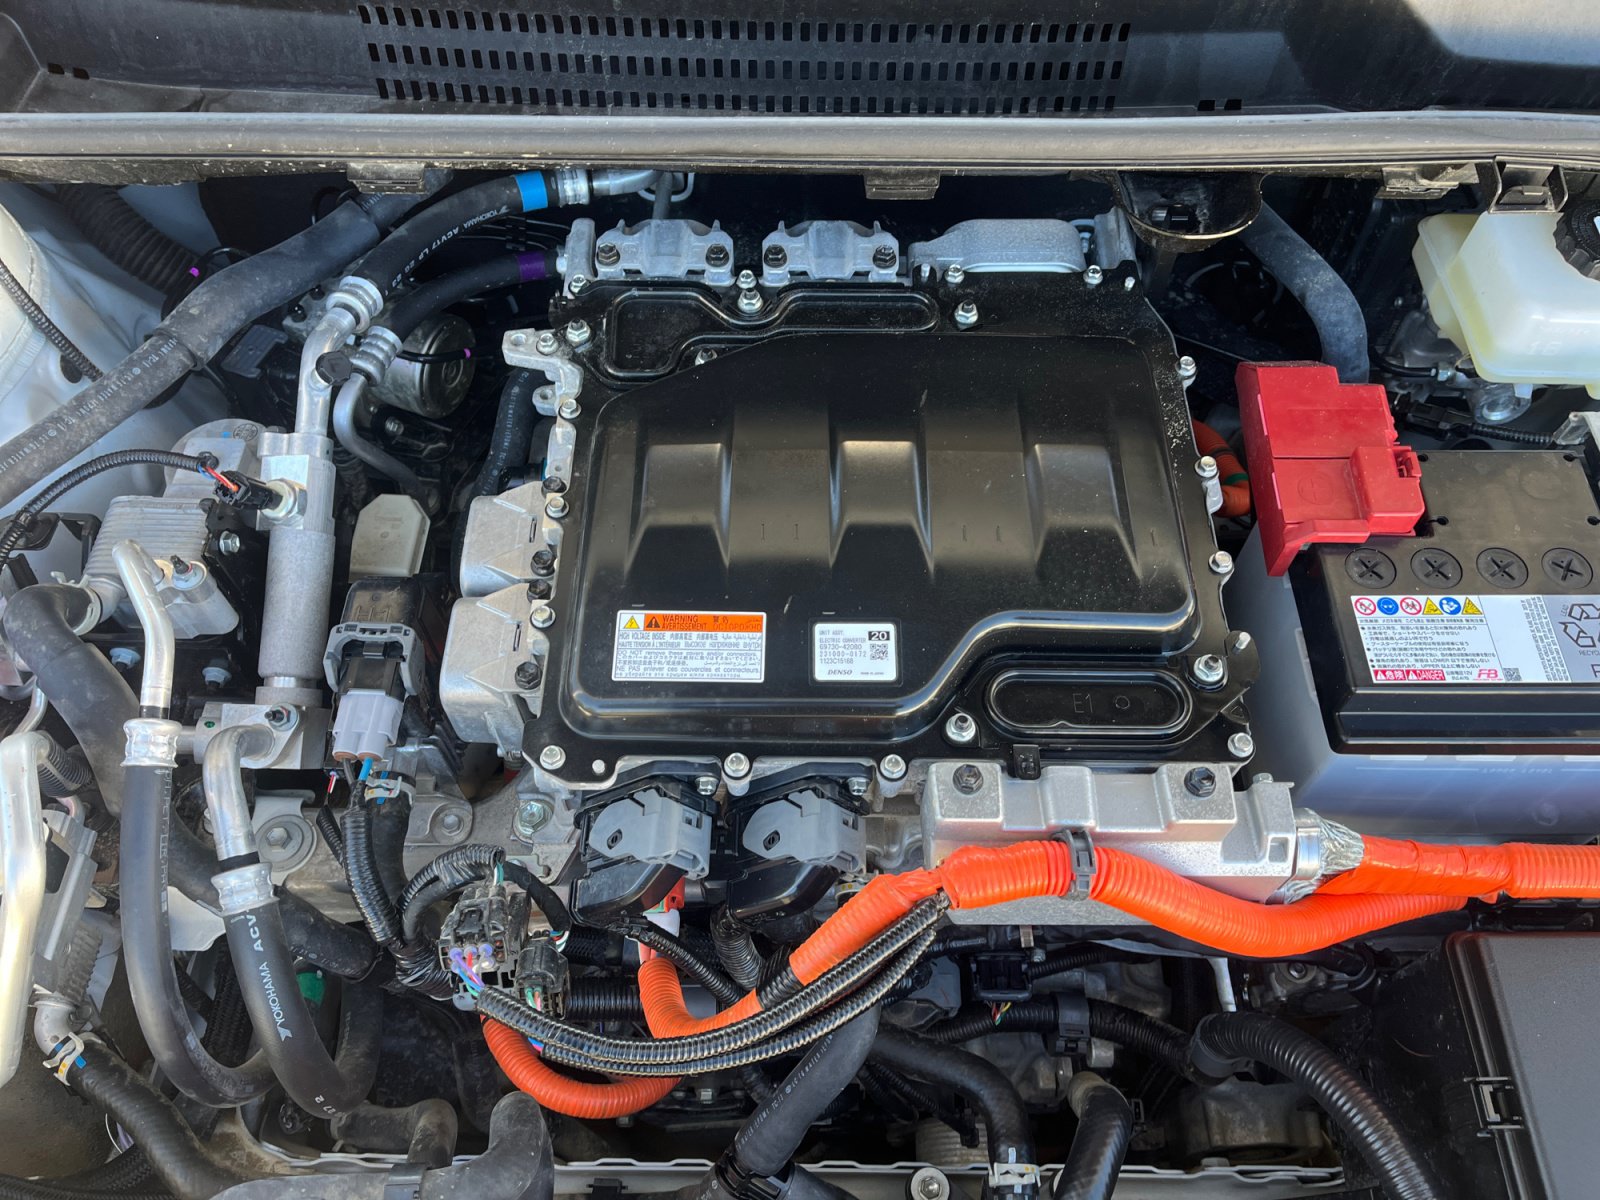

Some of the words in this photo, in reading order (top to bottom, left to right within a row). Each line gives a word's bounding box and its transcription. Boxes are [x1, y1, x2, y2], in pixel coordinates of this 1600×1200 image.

[463, 210, 498, 228] YOKOHAMA
[432, 227, 458, 250] ACV17
[663, 615, 698, 623] WARNING
[871, 632, 887, 640] 20
[1416, 670, 1444, 680] DANGER
[1478, 669, 1498, 678] FB
[246, 912, 264, 951] ACV
[259, 962, 286, 1027] YOKOHAMA
